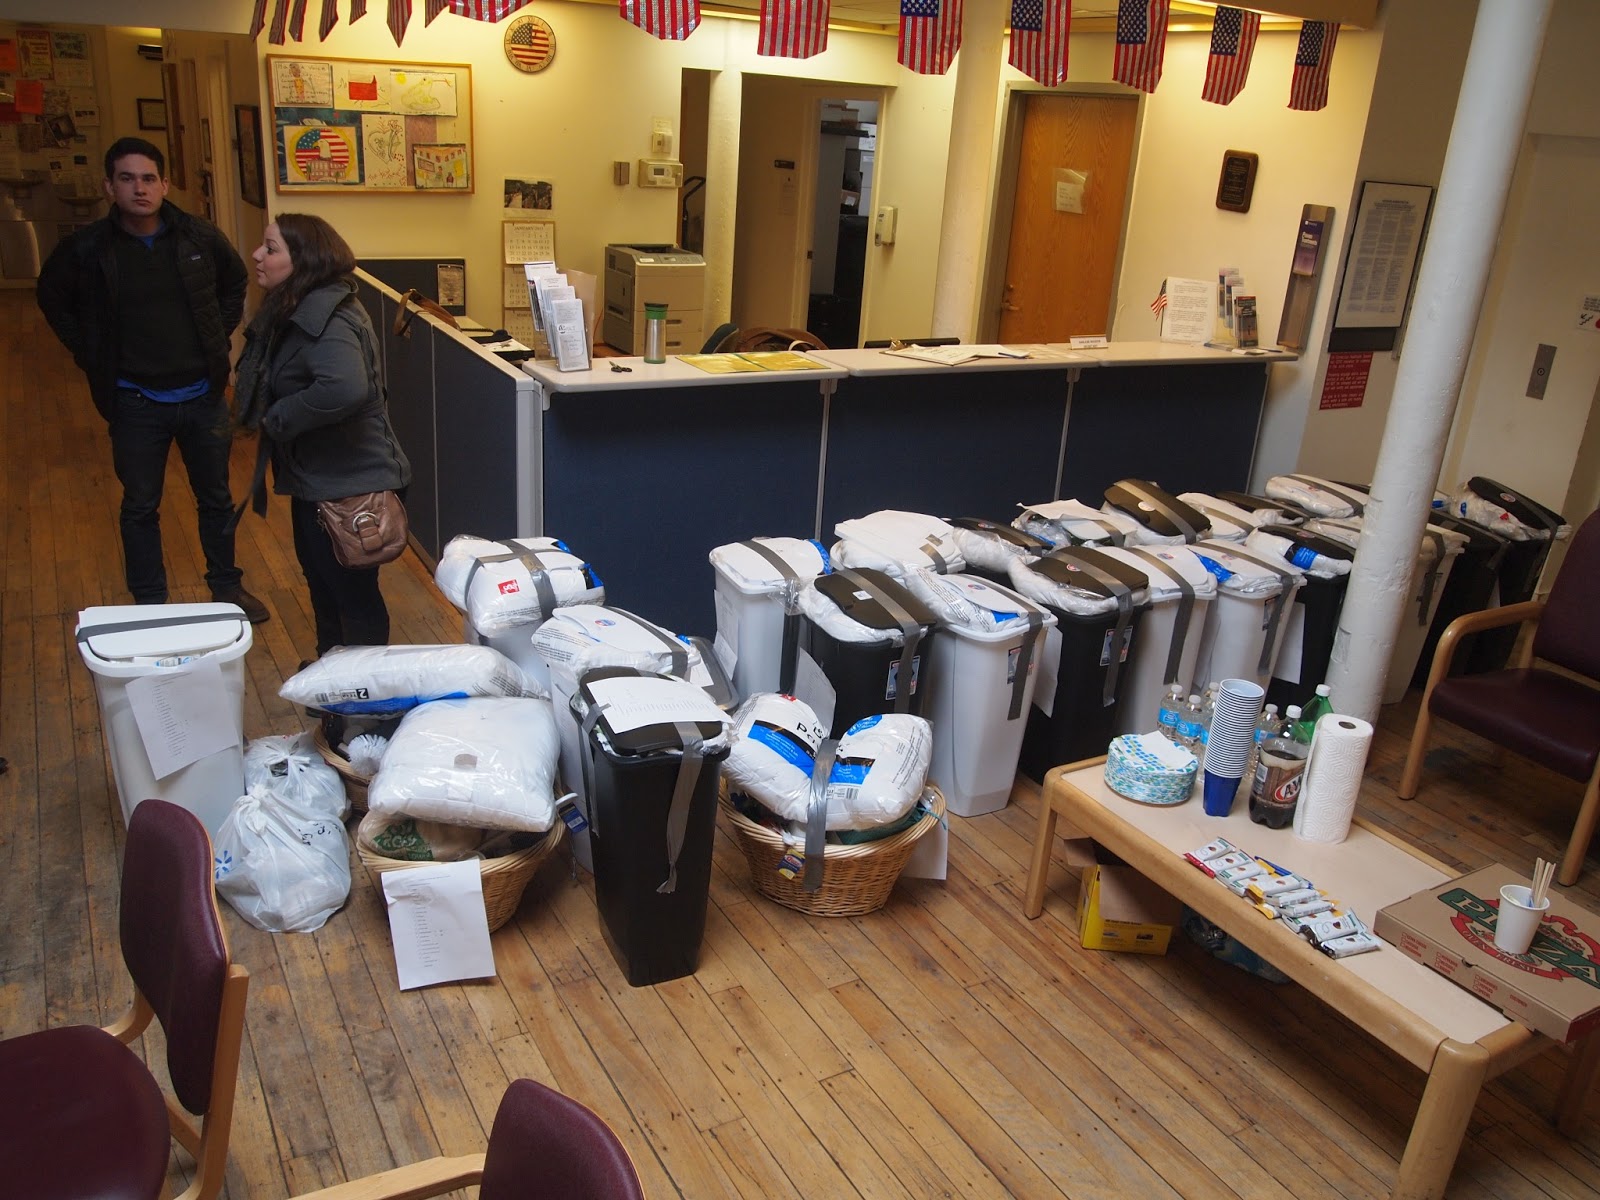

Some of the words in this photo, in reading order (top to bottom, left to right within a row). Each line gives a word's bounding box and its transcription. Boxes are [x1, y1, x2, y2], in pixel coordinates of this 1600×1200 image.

[358, 689, 367, 699] 2
[1451, 896, 1599, 983] PIZA
[1462, 928, 1488, 952] OVEN
[1495, 952, 1538, 974] FRESH
